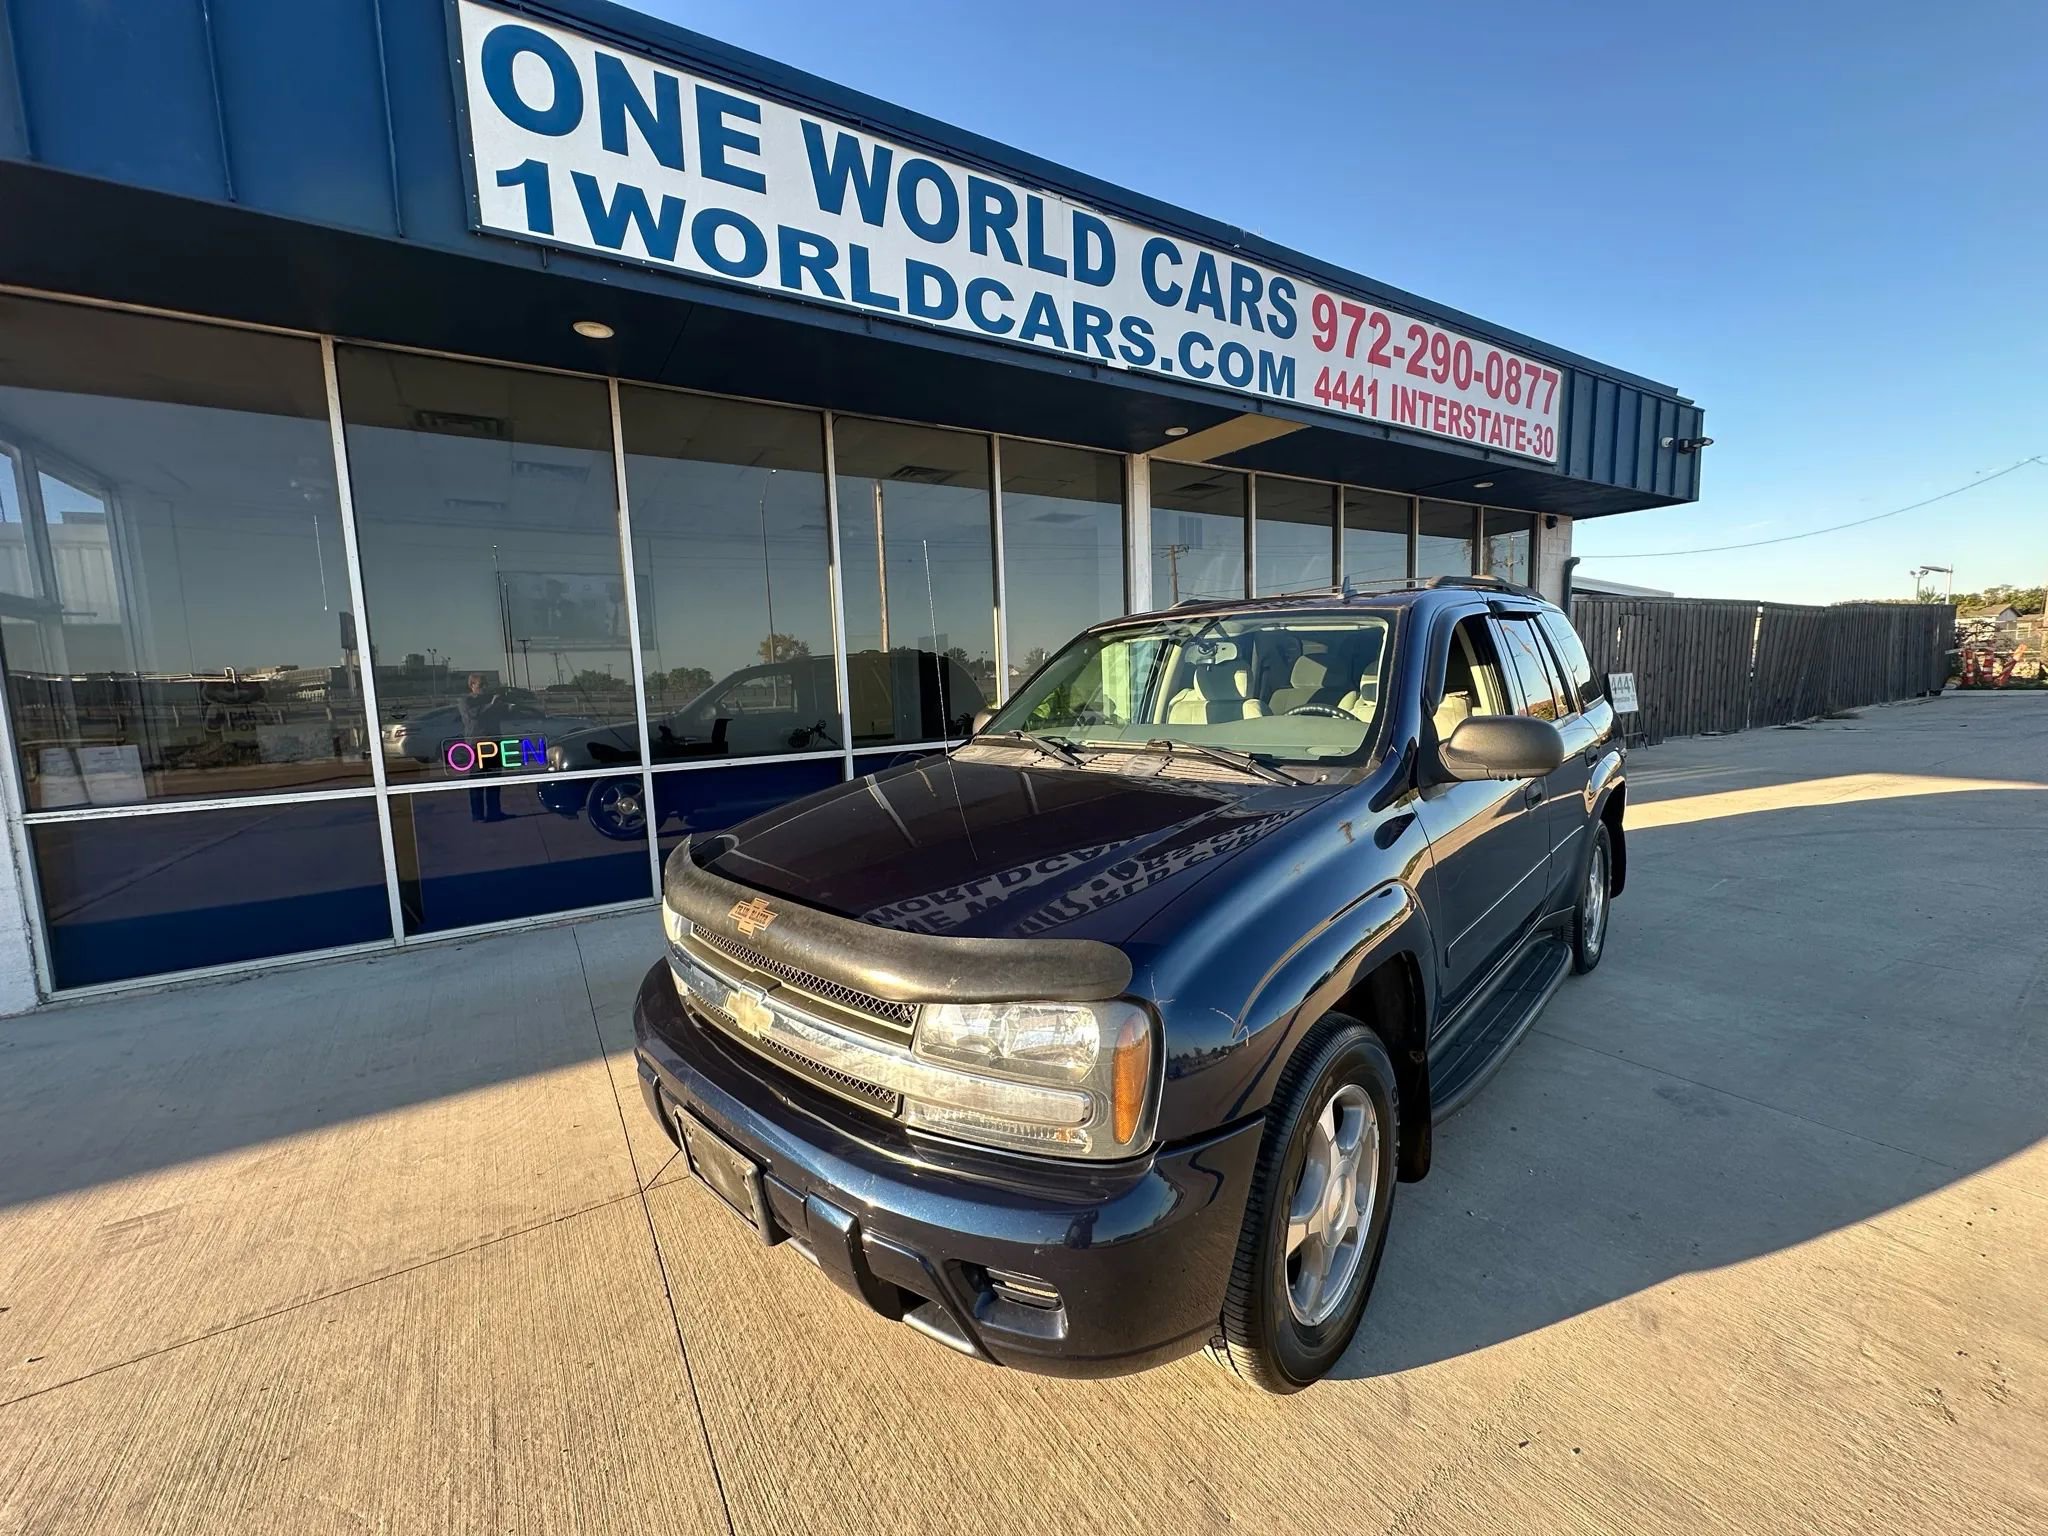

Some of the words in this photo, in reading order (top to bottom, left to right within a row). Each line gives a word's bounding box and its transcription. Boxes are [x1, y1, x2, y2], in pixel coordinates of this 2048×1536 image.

[481, 24, 766, 194] ONE
[800, 118, 1116, 287] WORLD
[1141, 237, 1298, 340] CARS
[495, 158, 1296, 399] 1WORLDCARS.COM
[1311, 293, 1559, 415] 972-290-0877
[1313, 366, 1380, 415] 4441
[1391, 384, 1555, 459] INTERSTATE-30
[447, 737, 548, 771] OPEN
